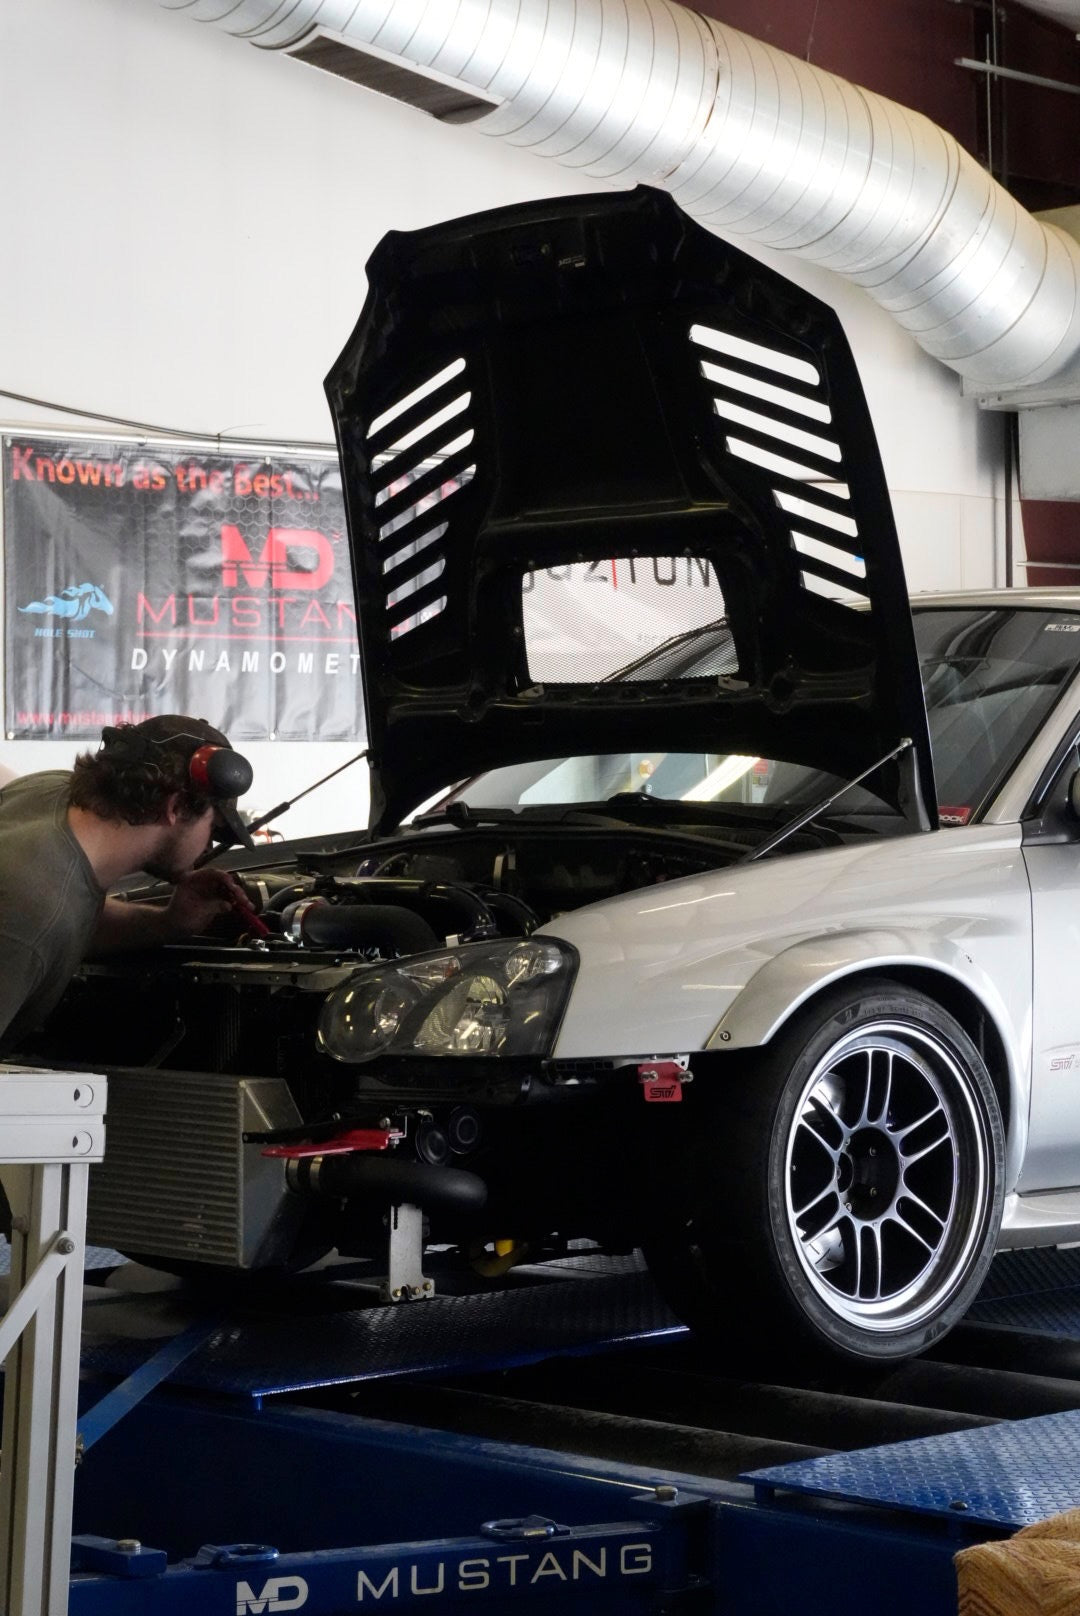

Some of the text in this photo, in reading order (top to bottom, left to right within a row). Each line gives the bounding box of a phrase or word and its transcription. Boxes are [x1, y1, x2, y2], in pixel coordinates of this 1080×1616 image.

[11, 445, 127, 487] Known
[132, 463, 166, 491] as
[174, 460, 225, 495] the
[220, 523, 335, 591] MD
[236, 1575, 309, 1616] MD
[357, 1543, 652, 1601] MUSTANG
